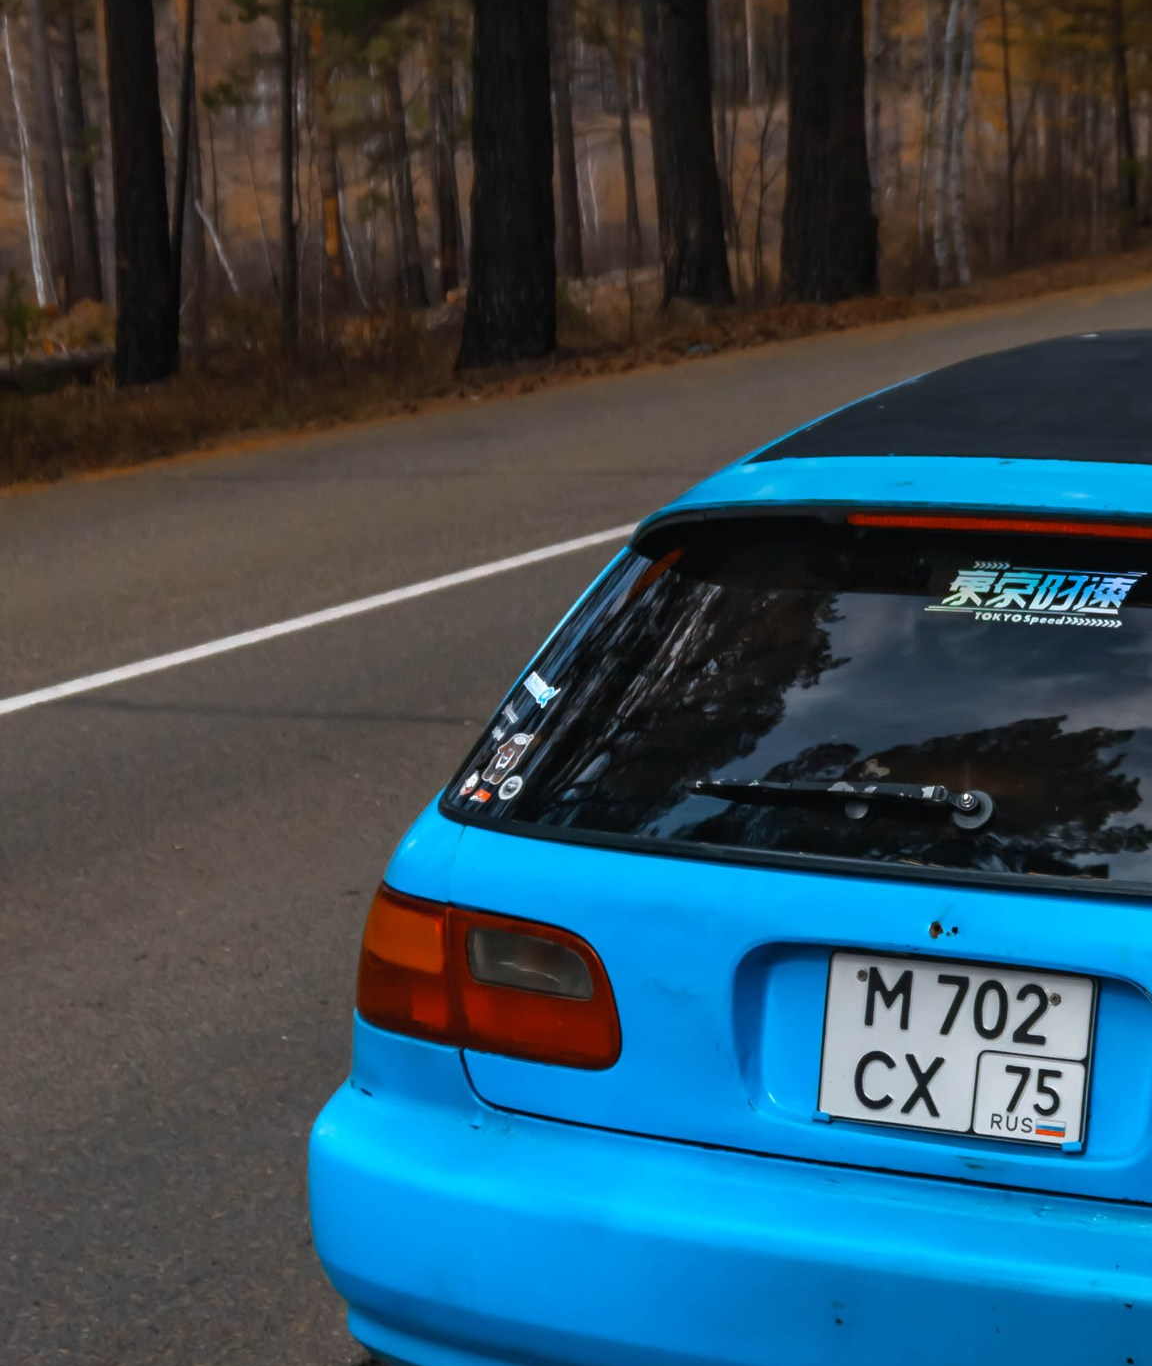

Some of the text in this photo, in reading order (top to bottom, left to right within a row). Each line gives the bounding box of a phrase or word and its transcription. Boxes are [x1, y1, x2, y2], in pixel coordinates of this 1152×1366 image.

[974, 611, 1066, 626] TOKYO Speed
[938, 974, 1050, 1046] 702
[1005, 1064, 1063, 1117] 75
[990, 1113, 1034, 1134] RUS
